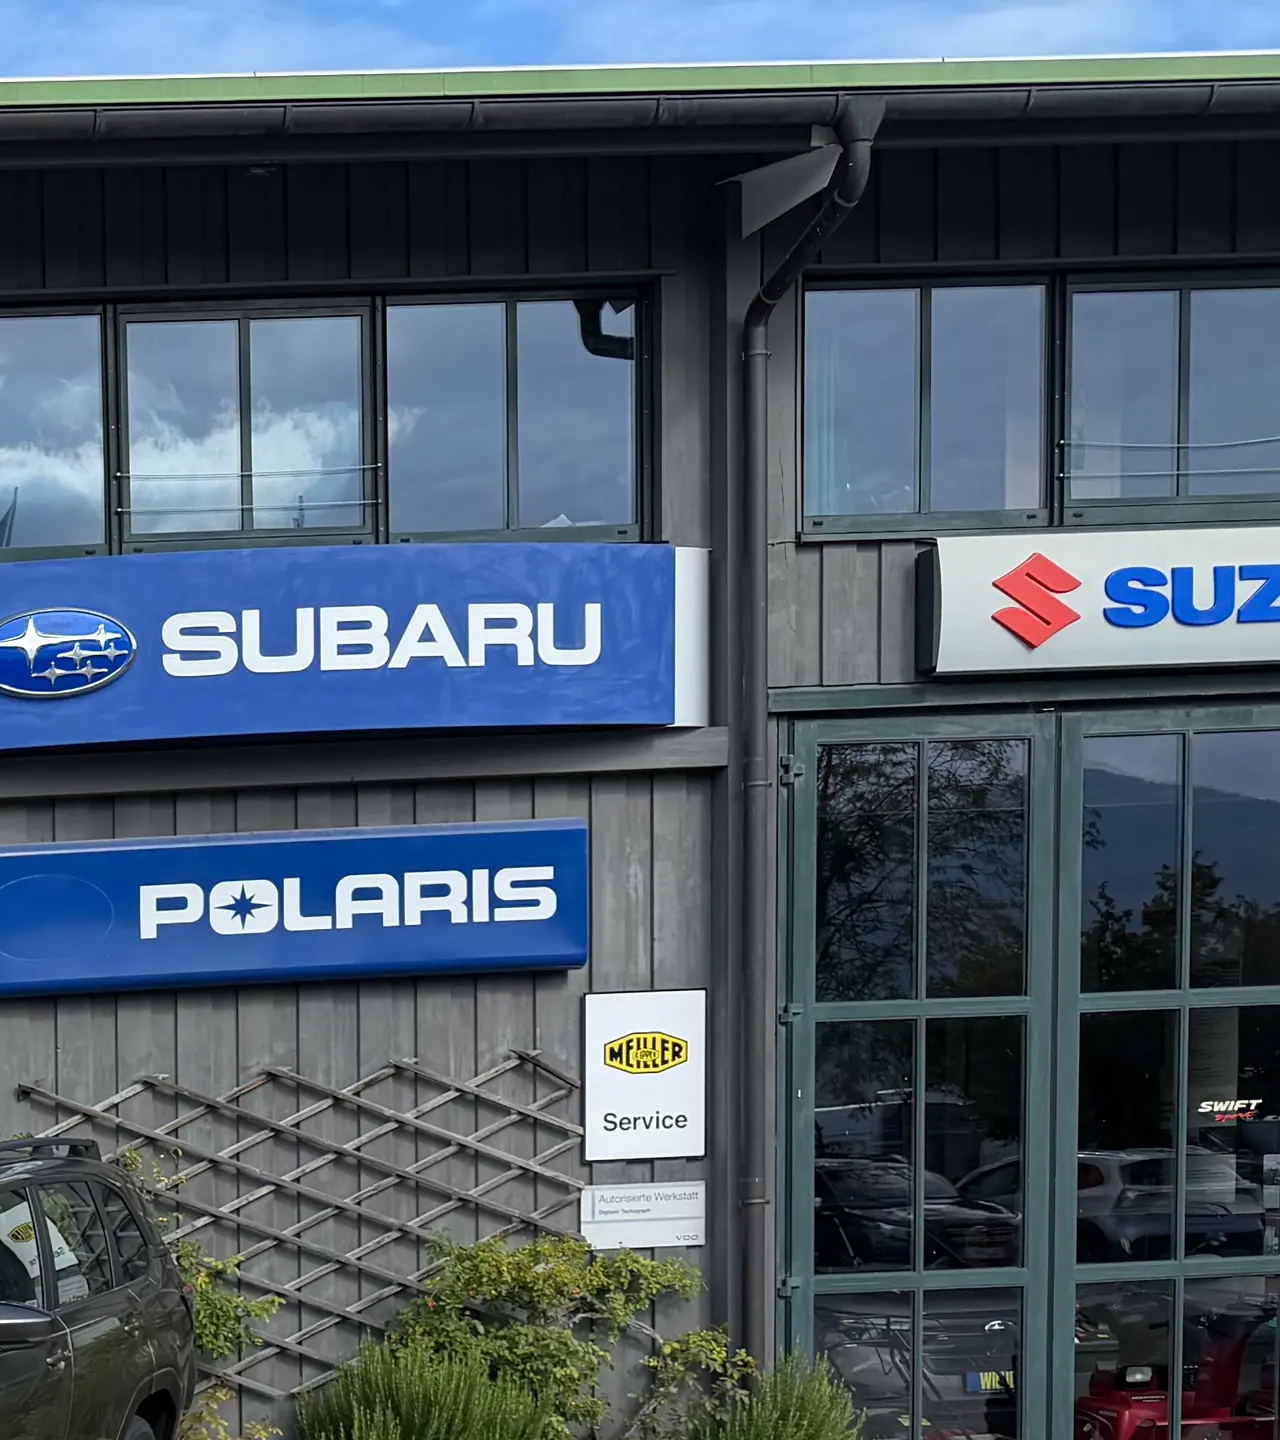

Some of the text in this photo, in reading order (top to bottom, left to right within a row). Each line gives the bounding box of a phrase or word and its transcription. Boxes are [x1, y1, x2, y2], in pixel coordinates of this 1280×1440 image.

[1102, 565, 1280, 629] SUZ
[162, 603, 602, 677] SUBARU
[140, 866, 558, 939] POLARIS
[609, 1036, 683, 1069] MEILLER
[603, 1110, 688, 1132] Service
[1197, 1099, 1263, 1113] SWIFT
[599, 1191, 699, 1204] Autorisierte Werkstatt
